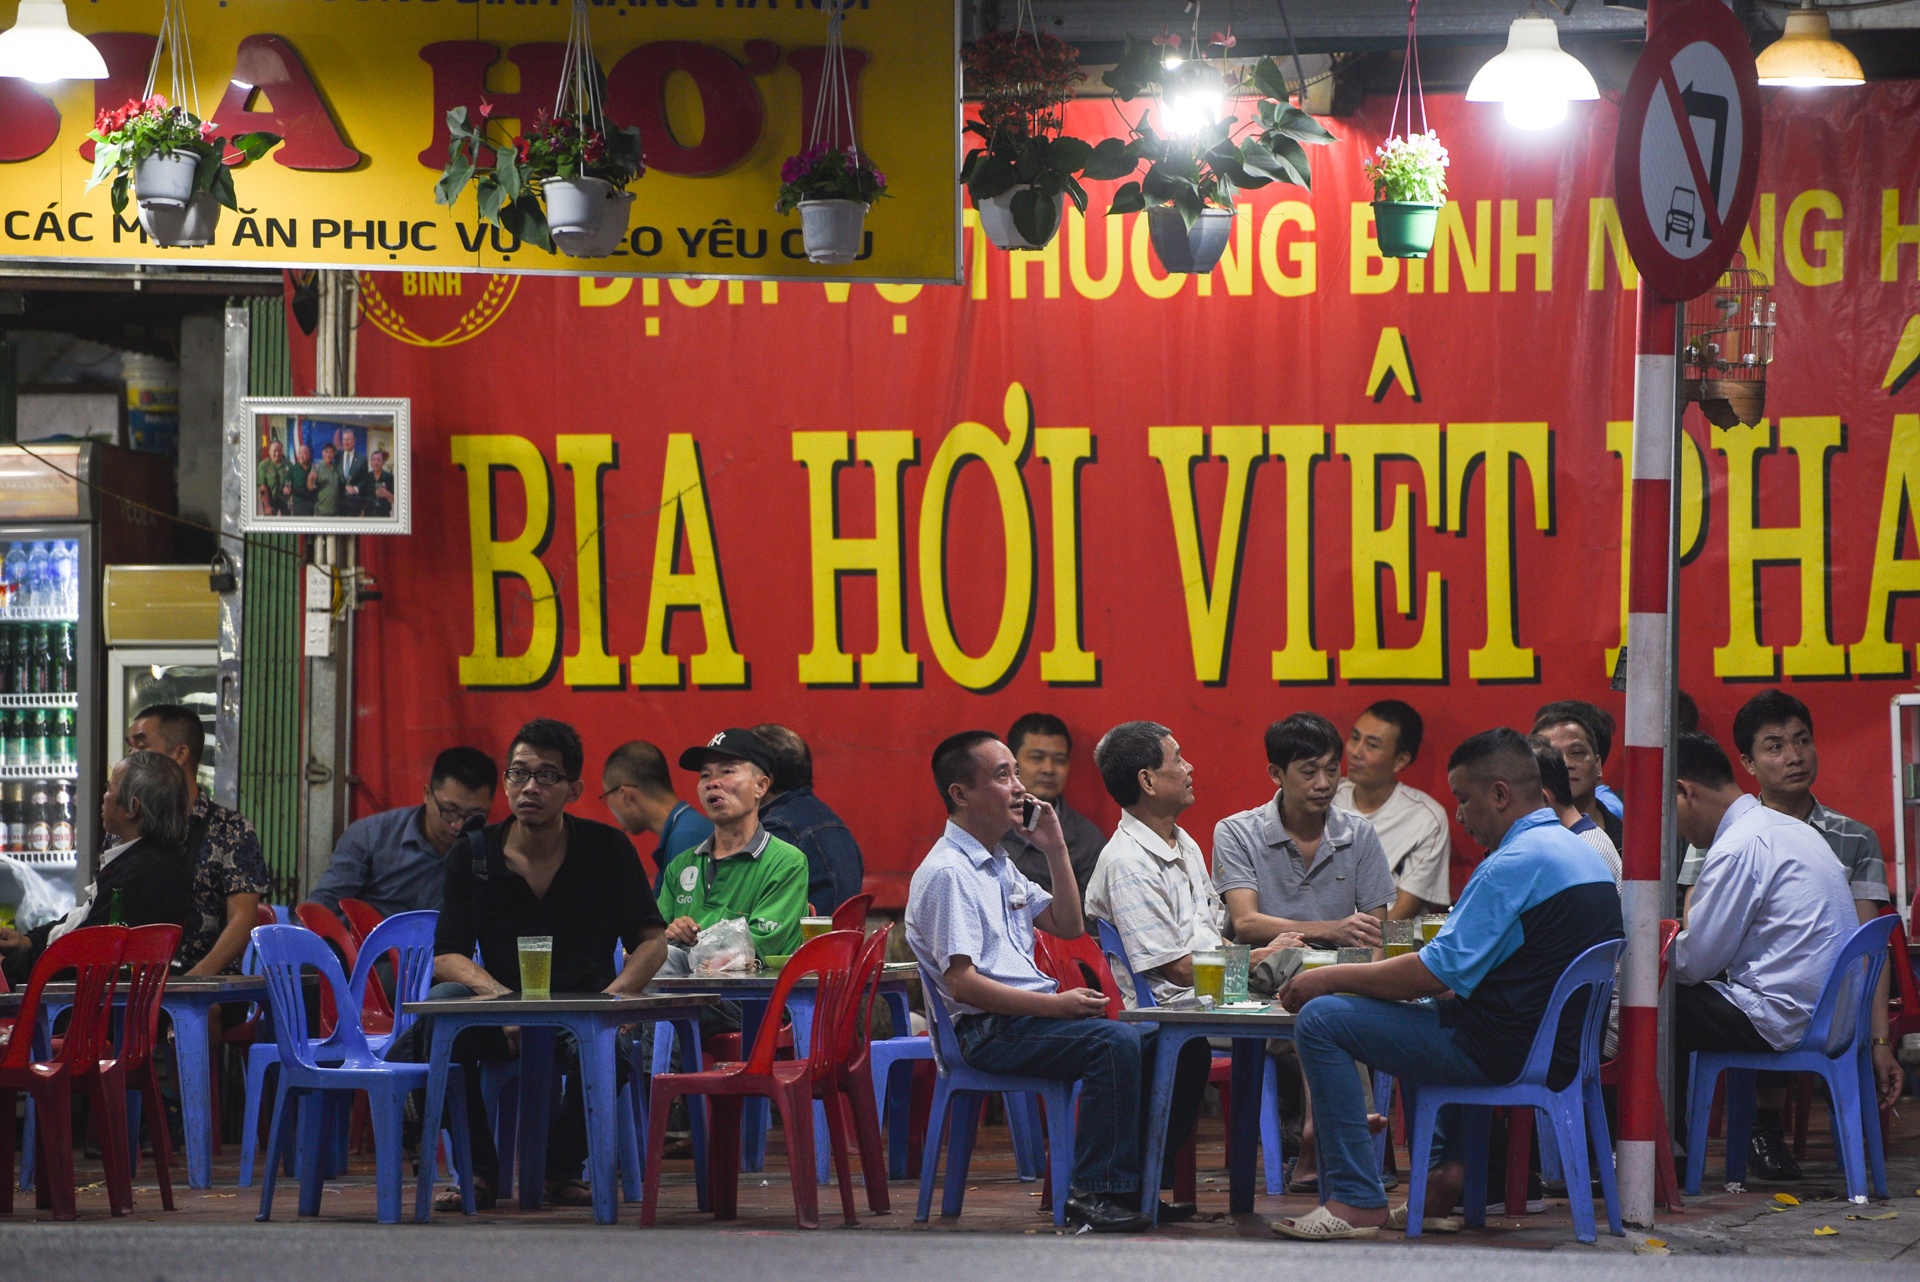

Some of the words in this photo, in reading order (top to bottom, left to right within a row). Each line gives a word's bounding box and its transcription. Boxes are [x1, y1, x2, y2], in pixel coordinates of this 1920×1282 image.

[0, 30, 361, 171] IA
[418, 39, 869, 177] HƠI
[4, 202, 94, 242] CÁC
[232, 207, 297, 248] ĂN
[312, 218, 437, 260] PHỤC
[455, 221, 521, 262] VỤ
[676, 218, 767, 259] YÊU
[451, 432, 748, 688] BIA
[792, 381, 1100, 692] HƠI
